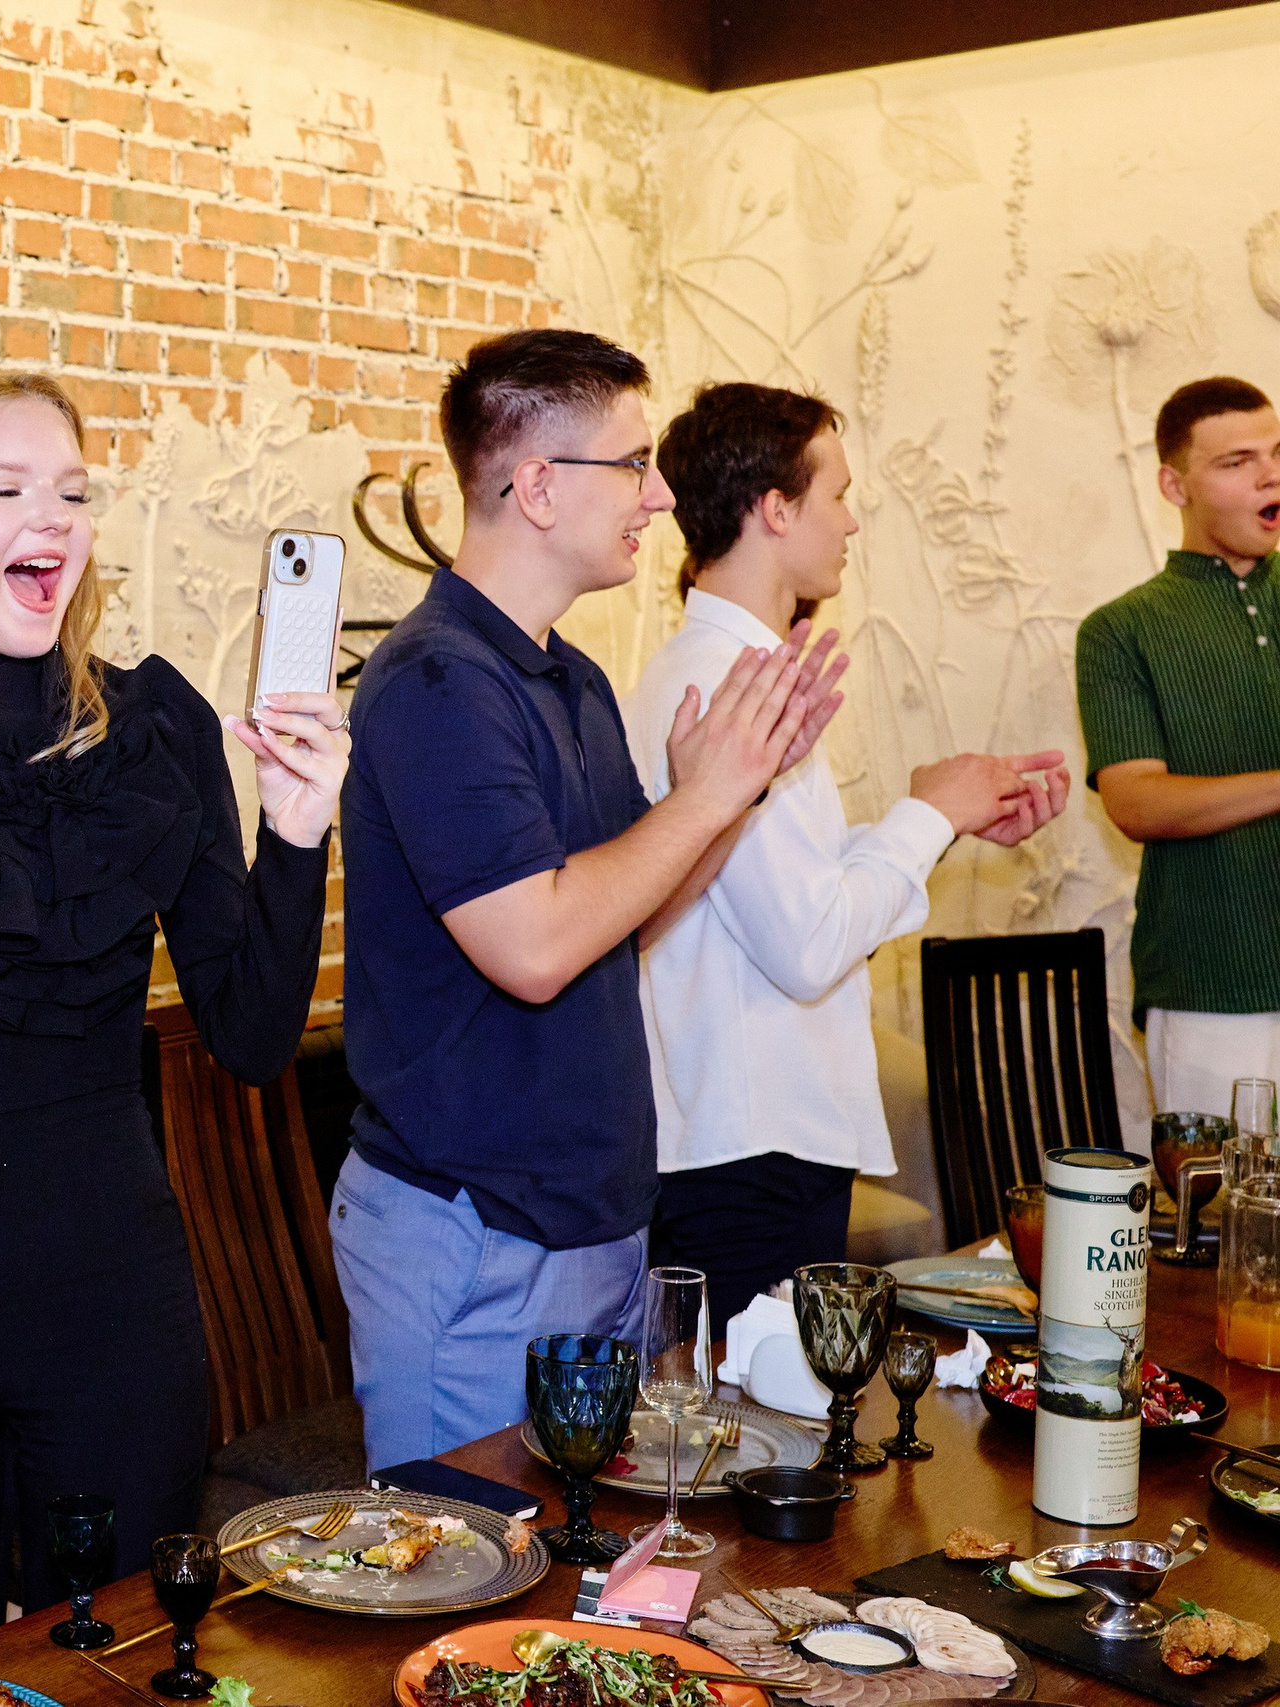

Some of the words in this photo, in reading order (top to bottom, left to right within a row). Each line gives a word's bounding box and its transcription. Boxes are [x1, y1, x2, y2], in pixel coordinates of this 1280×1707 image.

[1089, 1194, 1126, 1203] SPECIAL
[1087, 1245, 1147, 1272] RANO
[1104, 1288, 1138, 1300] SINGLE
[1093, 1300, 1134, 1311] SCOTCH
